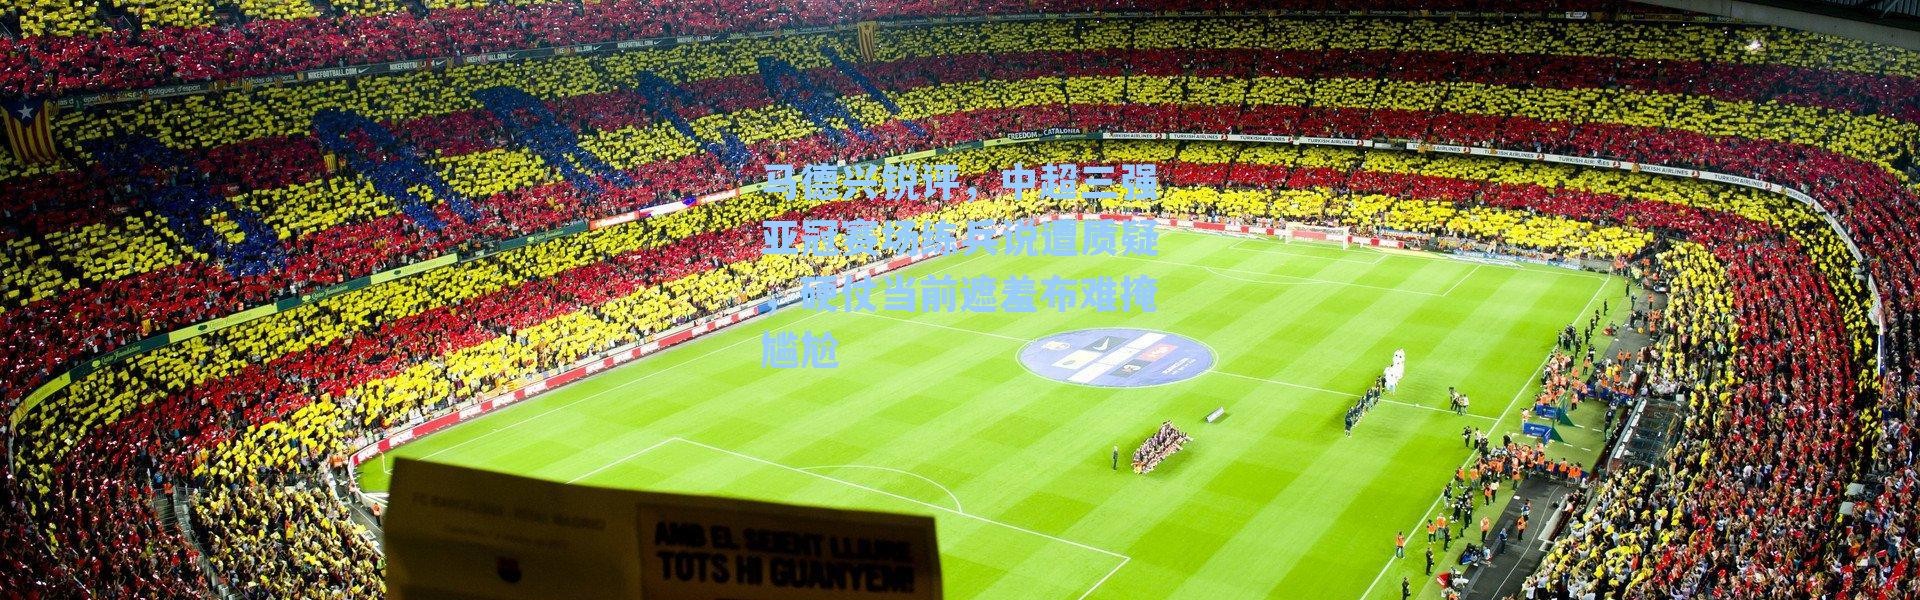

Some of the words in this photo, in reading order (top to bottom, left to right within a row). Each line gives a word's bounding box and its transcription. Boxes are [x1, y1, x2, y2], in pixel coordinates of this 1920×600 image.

[308, 67, 358, 79] NIKEFOOTBALL.COM
[1007, 132, 1038, 140] FREEDOM
[1043, 128, 1080, 136] CATALONIA
[1508, 151, 1534, 159] AIRLINES
[1558, 156, 1583, 164] TURKISH
[1661, 167, 1689, 176] AIRLINES
[1714, 174, 1740, 184] TURKISH
[1739, 178, 1763, 188] AIRLINES
[656, 521, 705, 548] AMB
[711, 525, 739, 550] EL
[656, 551, 731, 583] TOTS
[735, 556, 764, 587] HI
